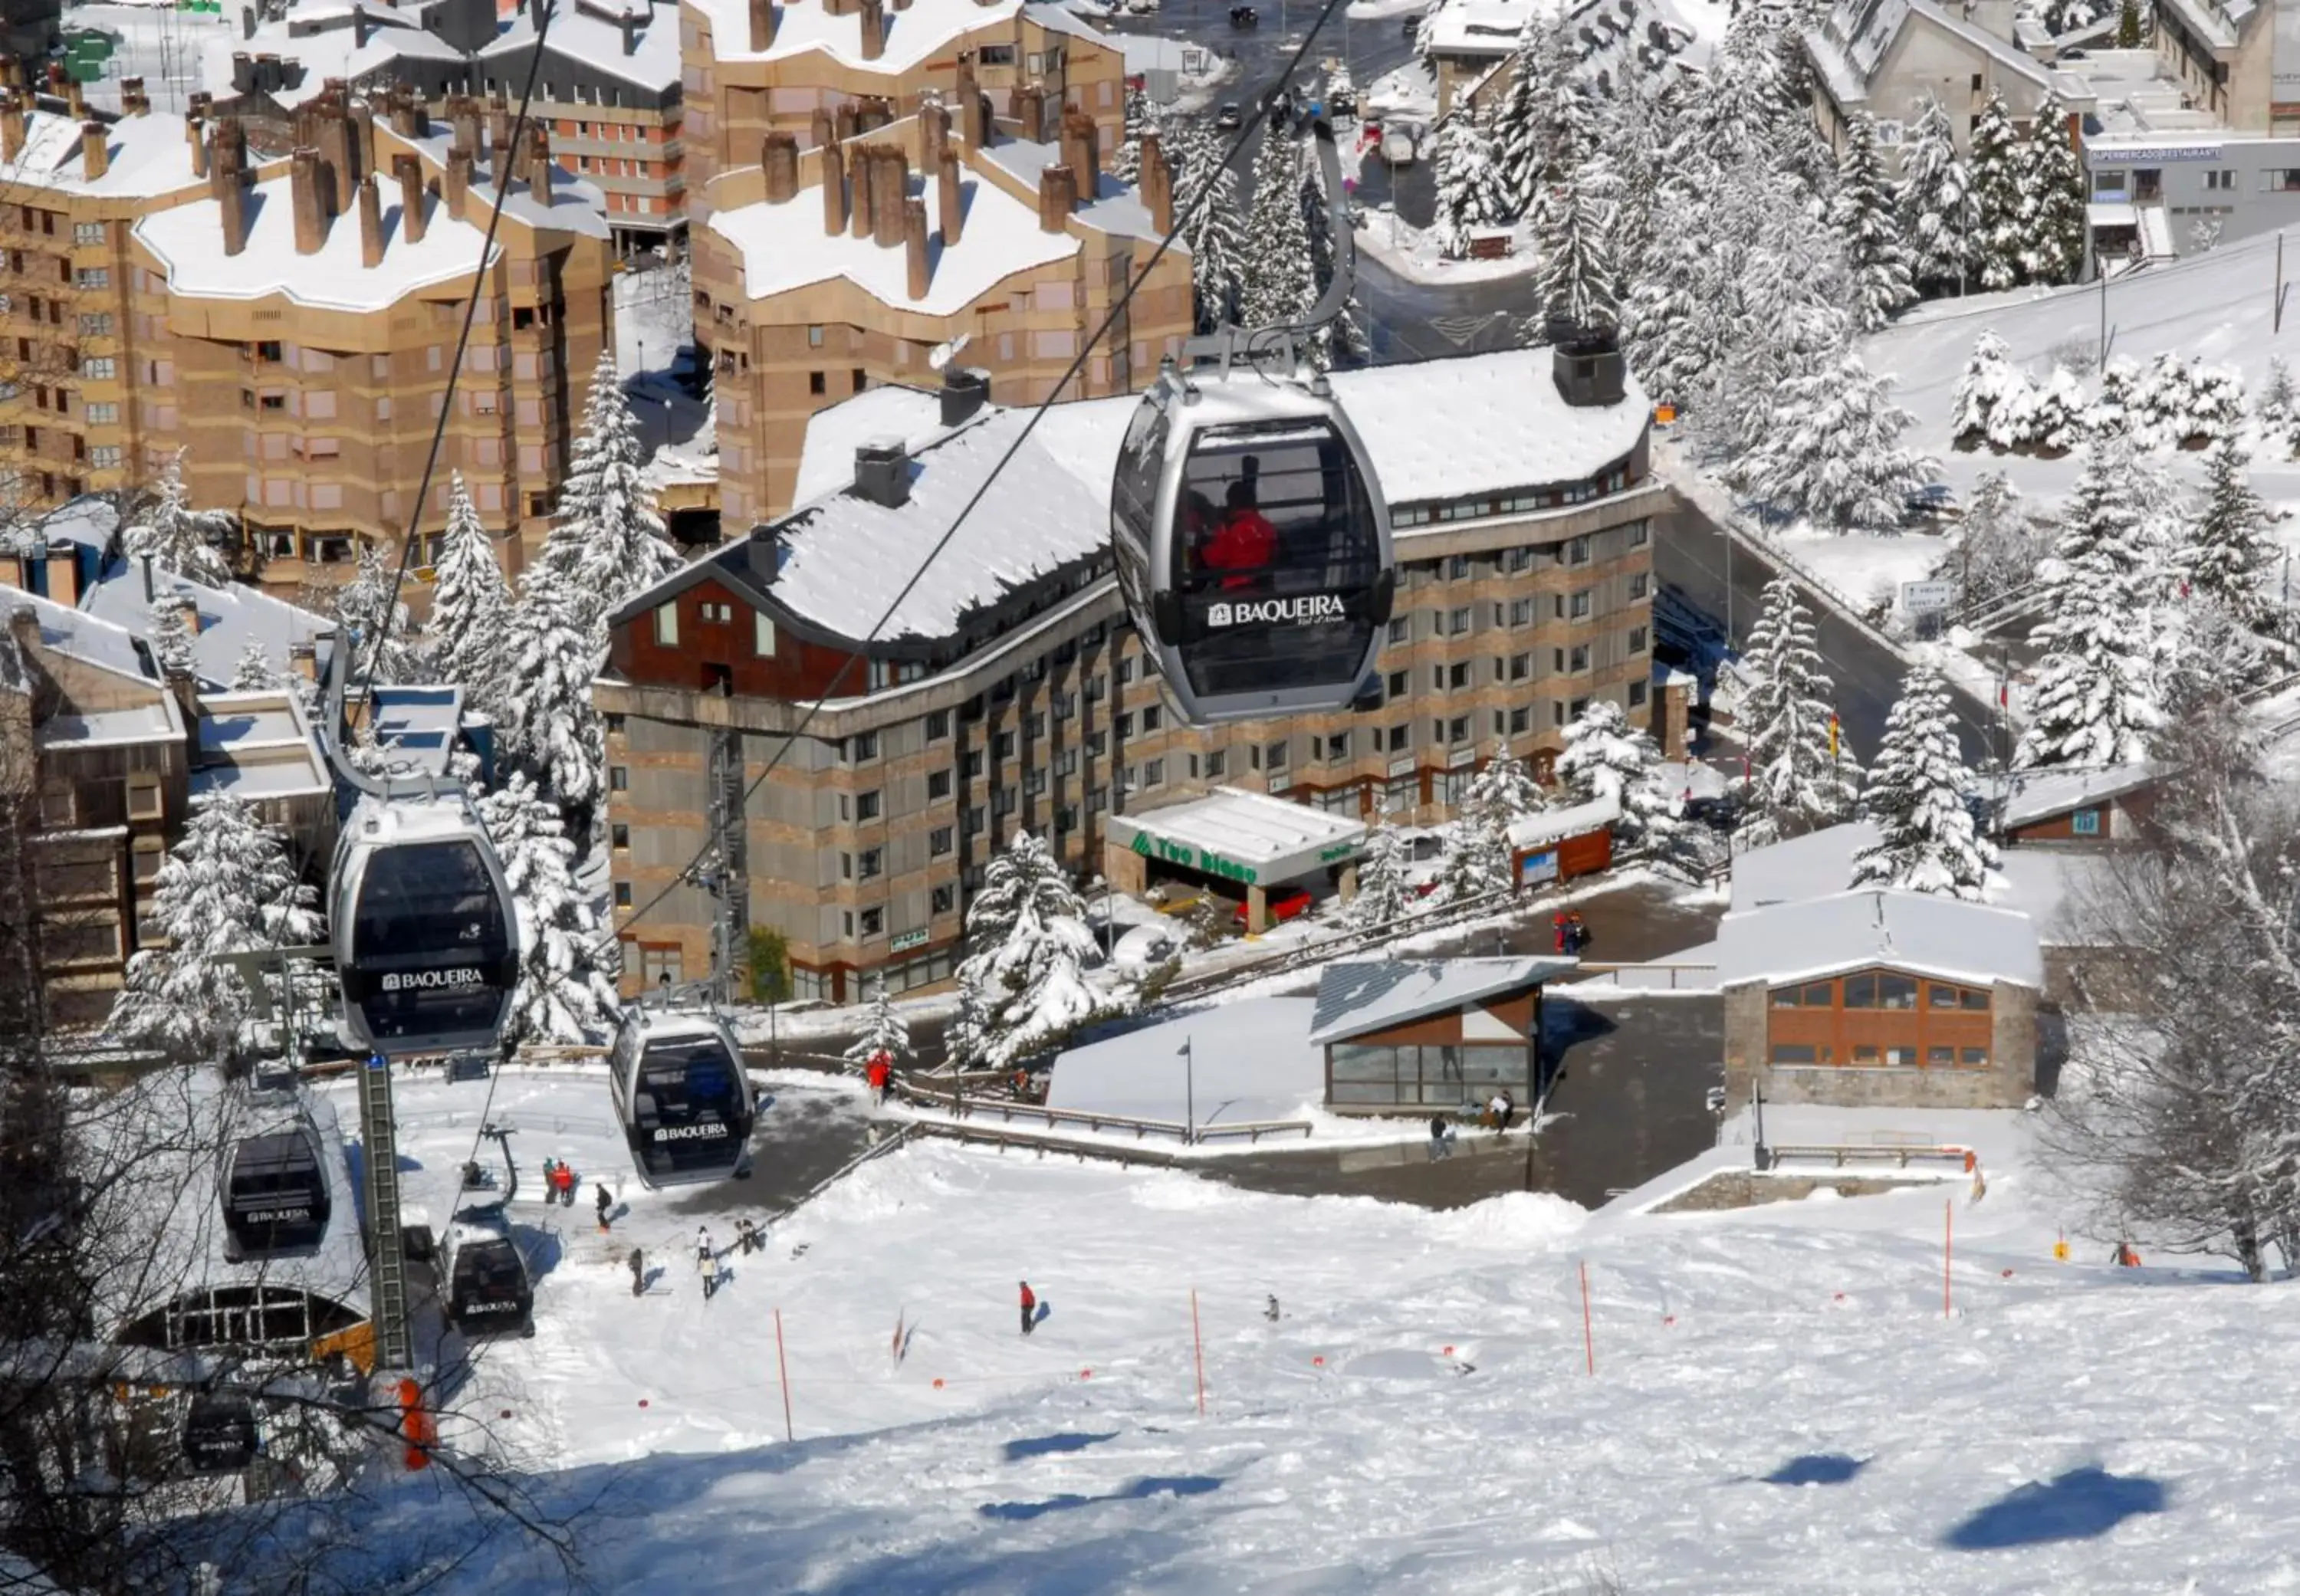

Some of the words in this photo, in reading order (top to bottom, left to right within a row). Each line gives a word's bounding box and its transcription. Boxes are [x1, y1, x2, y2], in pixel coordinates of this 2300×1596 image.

[2092, 149, 2160, 161] SUPERMERCADO
[2161, 147, 2220, 158] RESTAURANTE
[1235, 595, 1345, 623] BAQUEIRA
[402, 968, 484, 988] BAQUEIRA
[669, 1123, 728, 1140] BAQUEIRA
